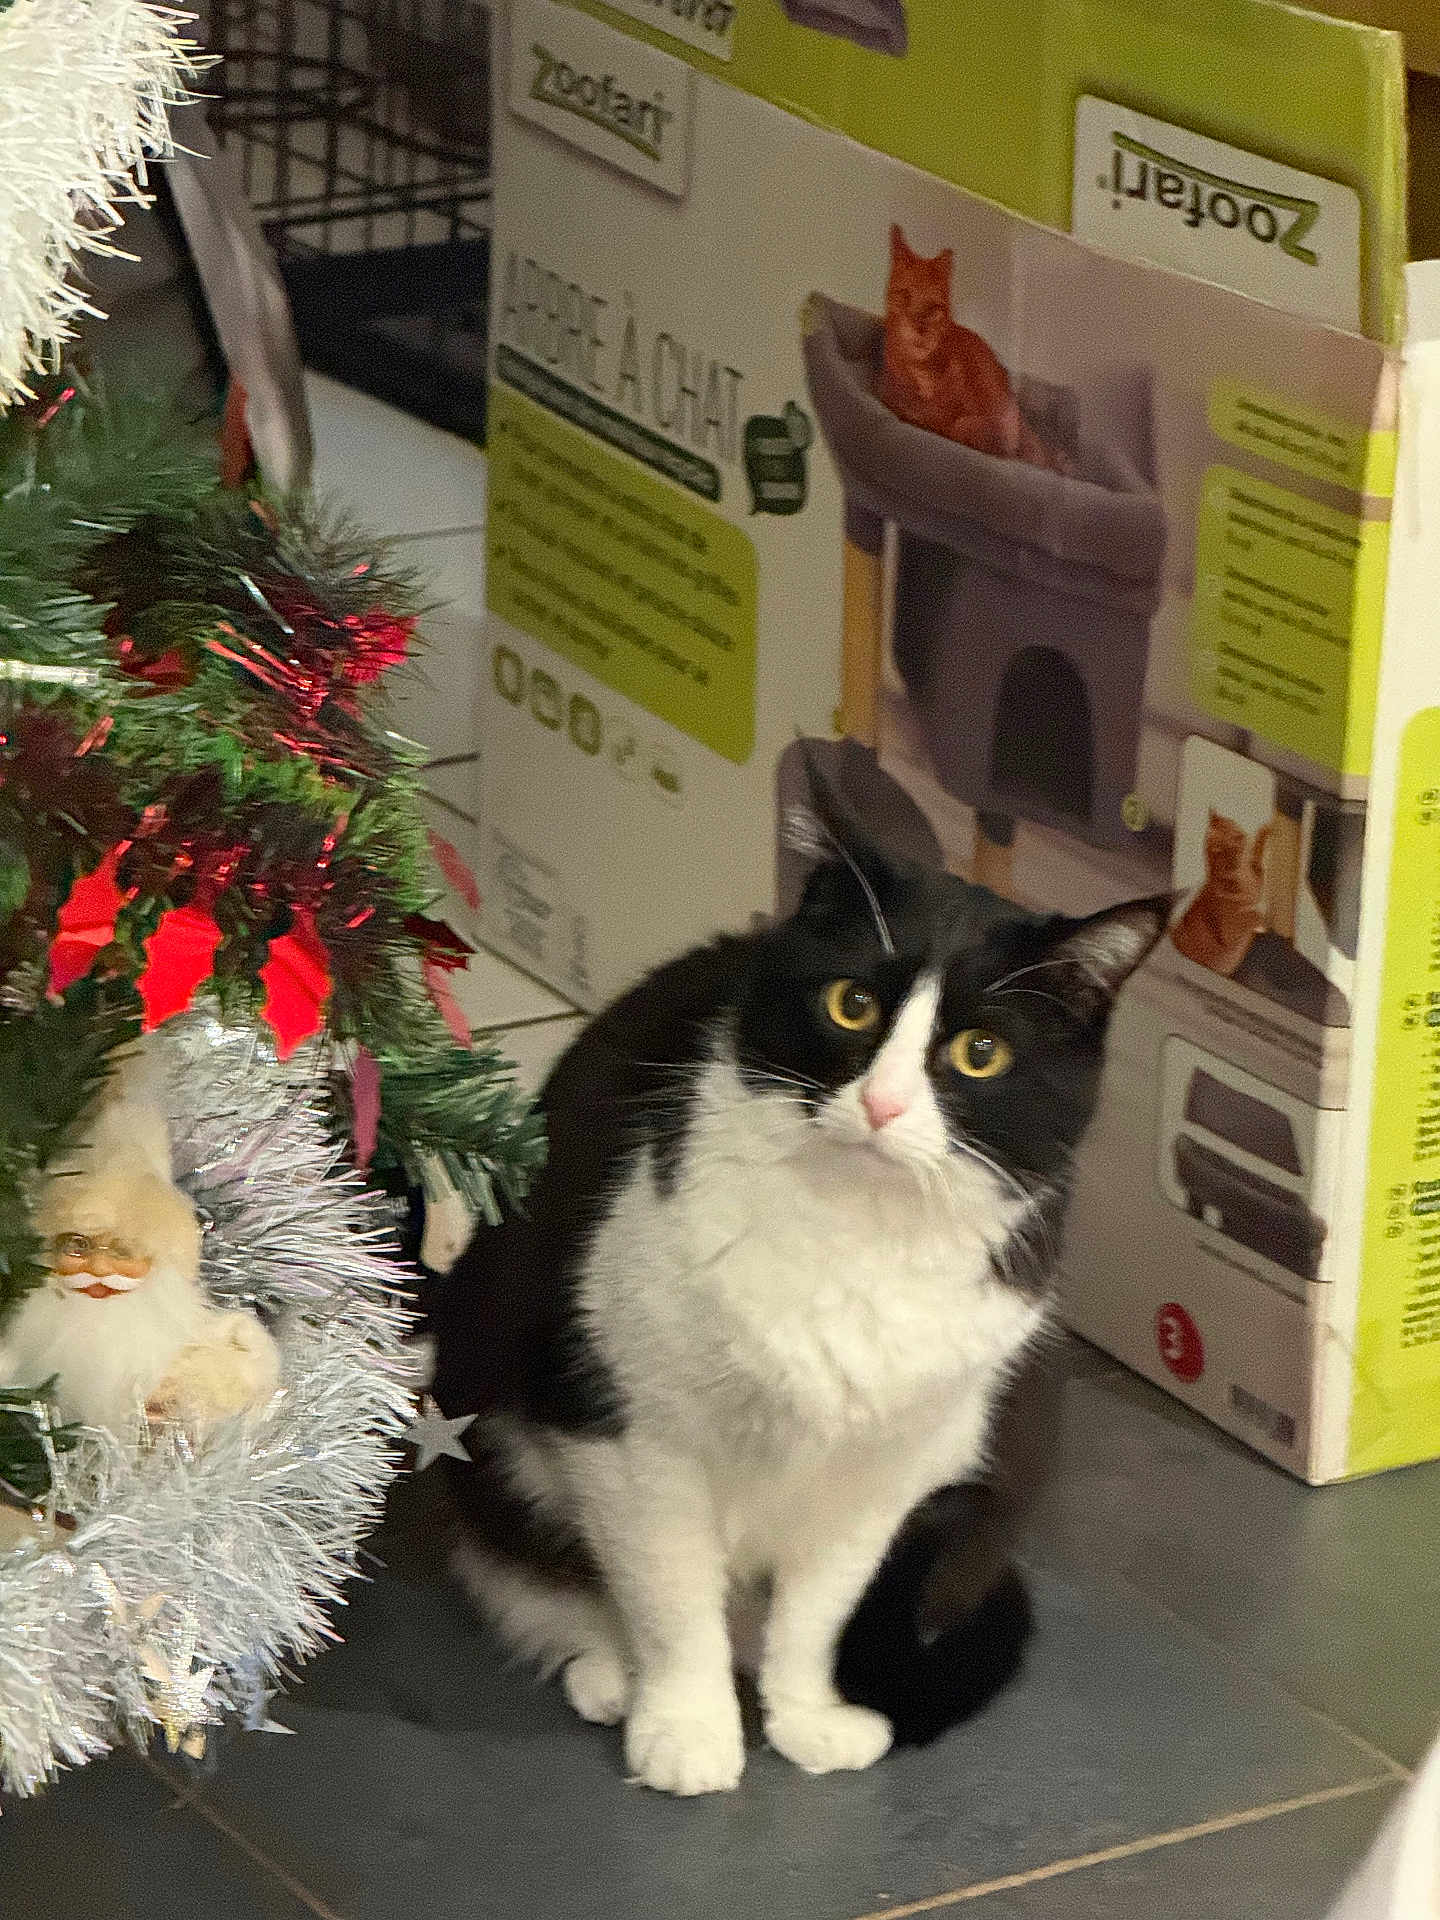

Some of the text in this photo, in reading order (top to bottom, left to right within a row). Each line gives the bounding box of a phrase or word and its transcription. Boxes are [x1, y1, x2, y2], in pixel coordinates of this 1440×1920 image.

[530, 43, 672, 162] Zoofari
[1110, 130, 1320, 267] Zoofari
[653, 331, 743, 466] CHAT
